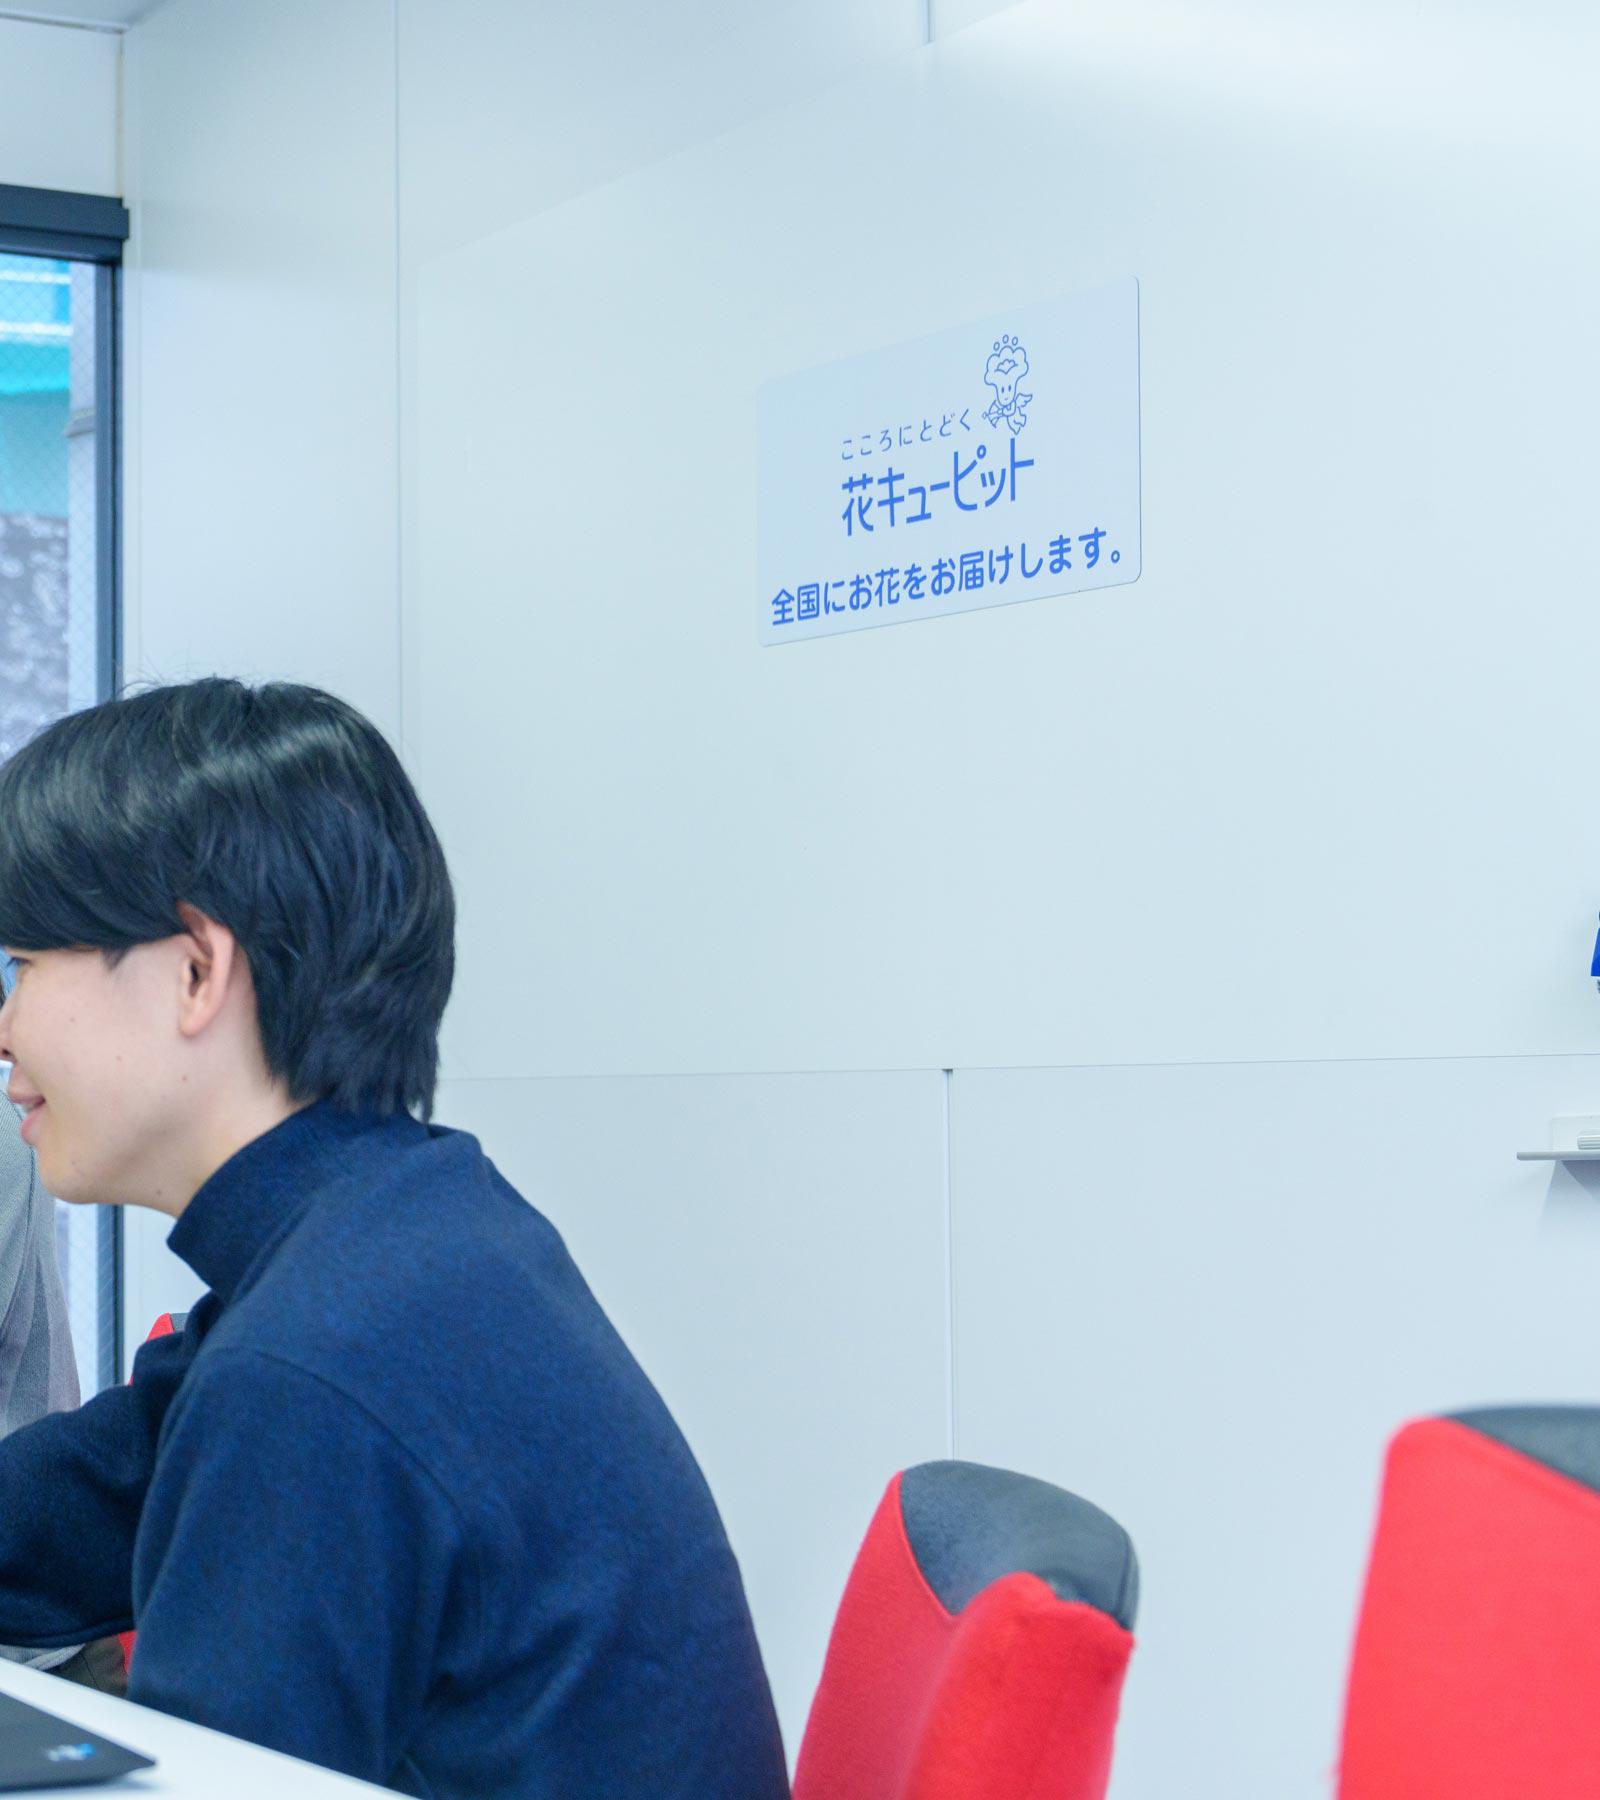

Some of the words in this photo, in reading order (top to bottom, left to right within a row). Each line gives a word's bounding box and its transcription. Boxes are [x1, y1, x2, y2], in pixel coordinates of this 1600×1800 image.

[840, 408, 972, 461] こころにとどく
[840, 437, 1036, 537] 花キューピット
[771, 526, 1121, 627] 全国にお花をお届けします。
